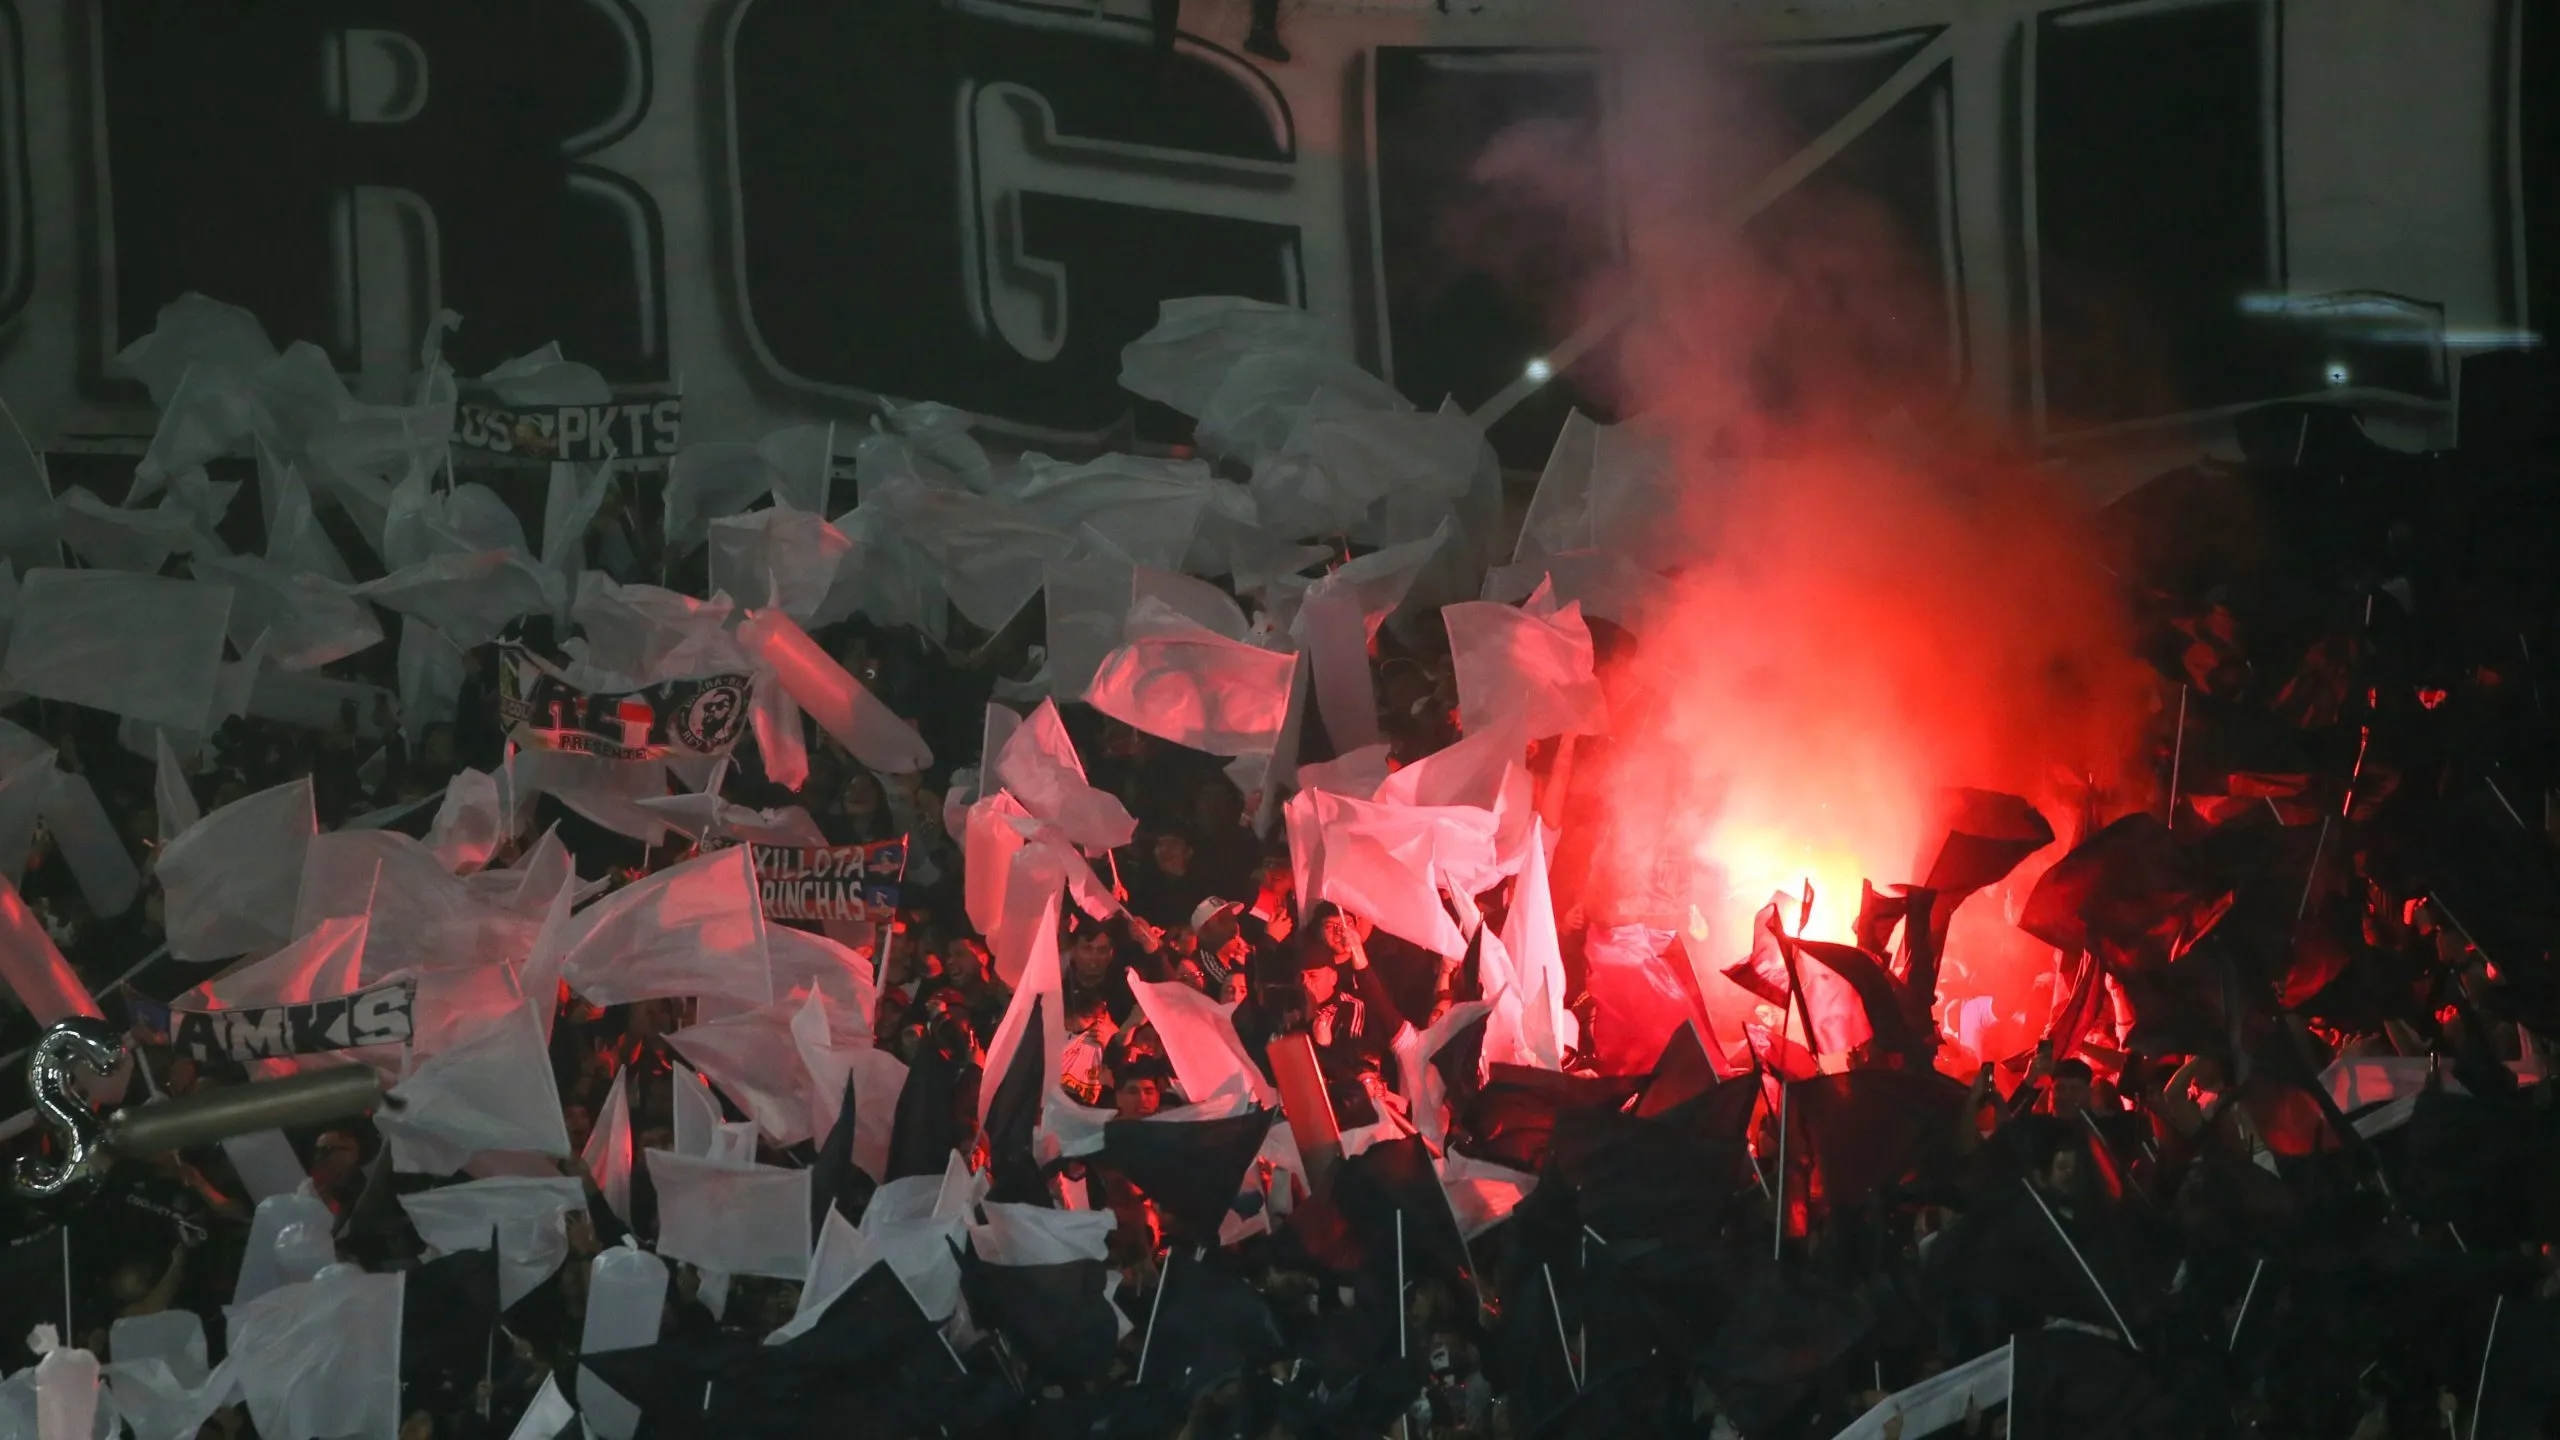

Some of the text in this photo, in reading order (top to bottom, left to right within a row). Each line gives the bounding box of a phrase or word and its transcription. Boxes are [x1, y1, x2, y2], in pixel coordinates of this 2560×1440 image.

[450, 400, 681, 460] OS PKTS
[168, 984, 413, 1063] AMKS
